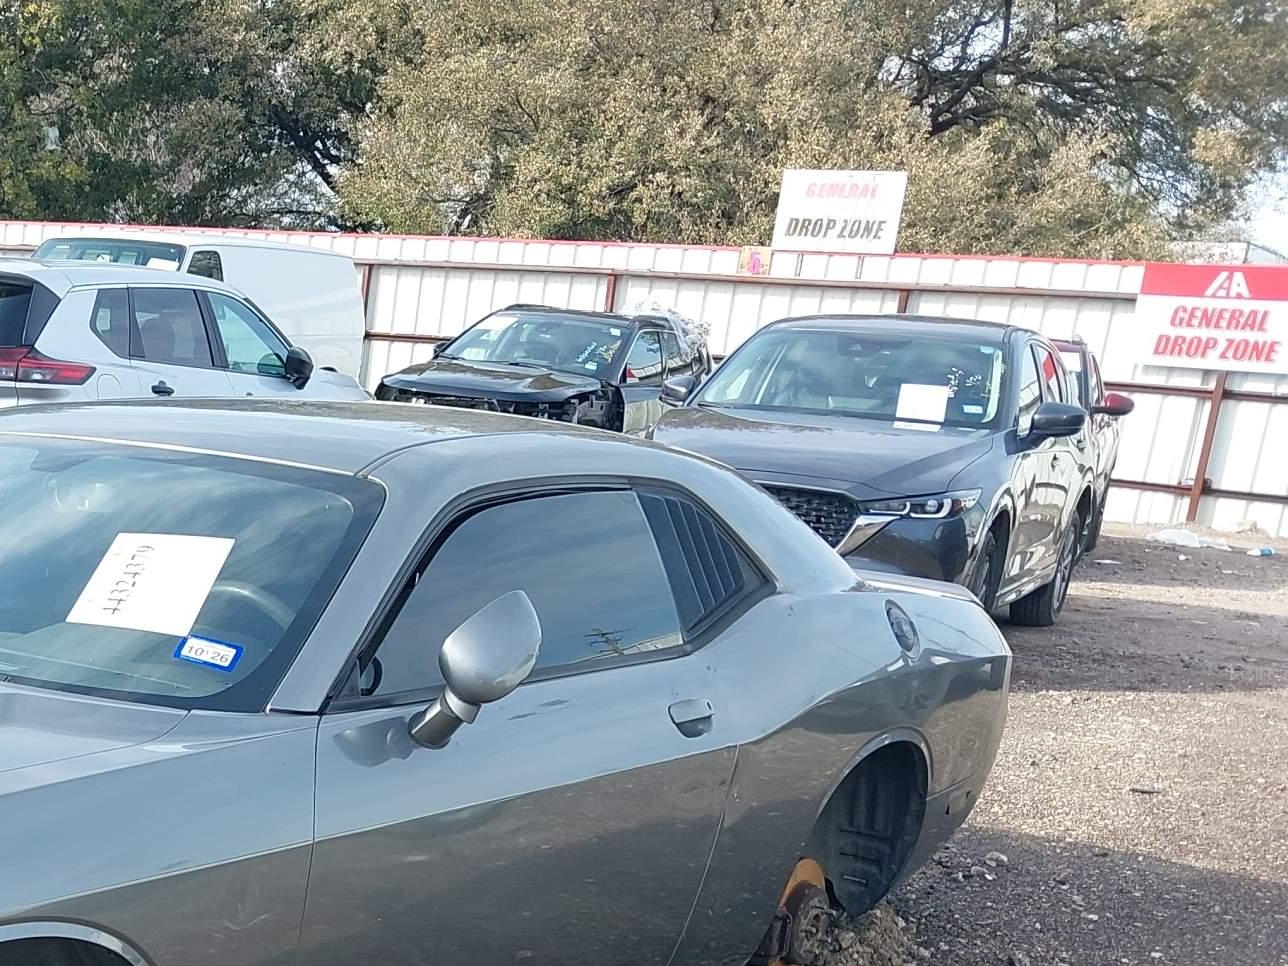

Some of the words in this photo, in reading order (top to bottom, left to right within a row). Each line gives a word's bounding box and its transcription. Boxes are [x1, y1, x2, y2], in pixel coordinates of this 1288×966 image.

[805, 182, 880, 200] GENERAL
[784, 217, 837, 238] DROP
[837, 218, 888, 240] ZONE
[1169, 304, 1271, 332] GENERAL
[1152, 334, 1219, 359] DROP
[1218, 337, 1283, 363] ZONE
